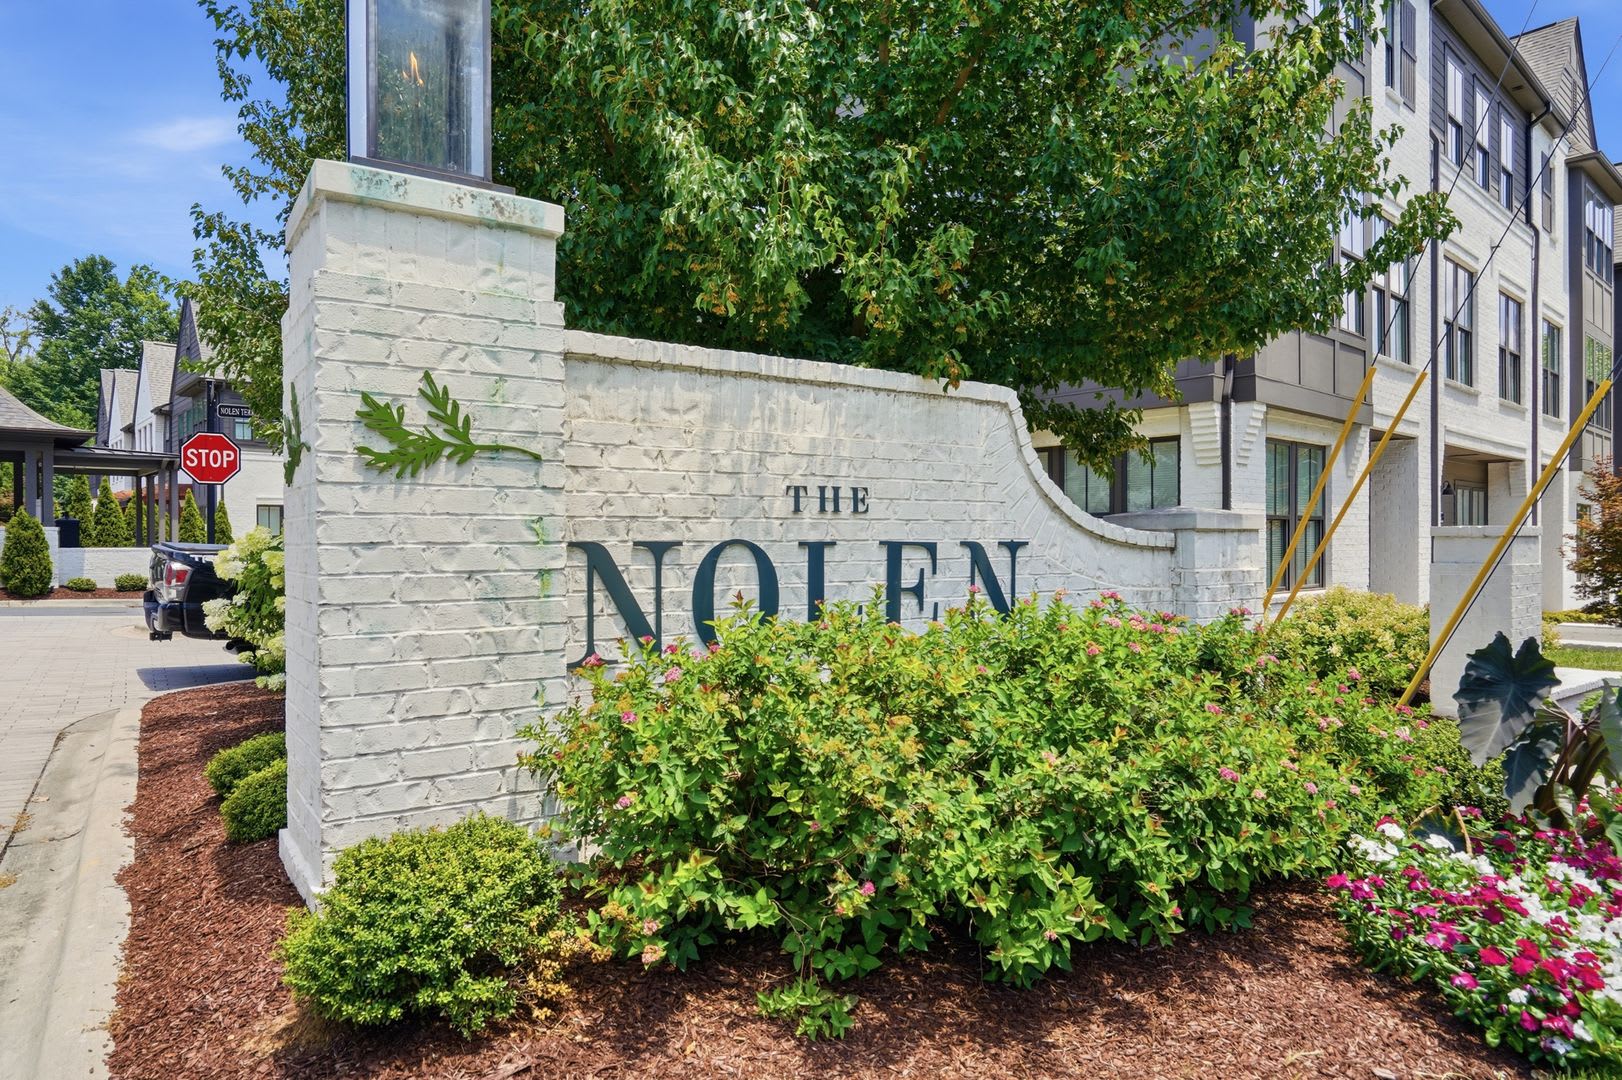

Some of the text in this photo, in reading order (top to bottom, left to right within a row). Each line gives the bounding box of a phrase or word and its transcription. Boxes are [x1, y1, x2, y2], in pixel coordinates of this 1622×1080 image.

[220, 407, 240, 416] NOLEN
[185, 448, 235, 468] STOP
[786, 485, 869, 514] THE
[567, 538, 1029, 669] NOLEN
